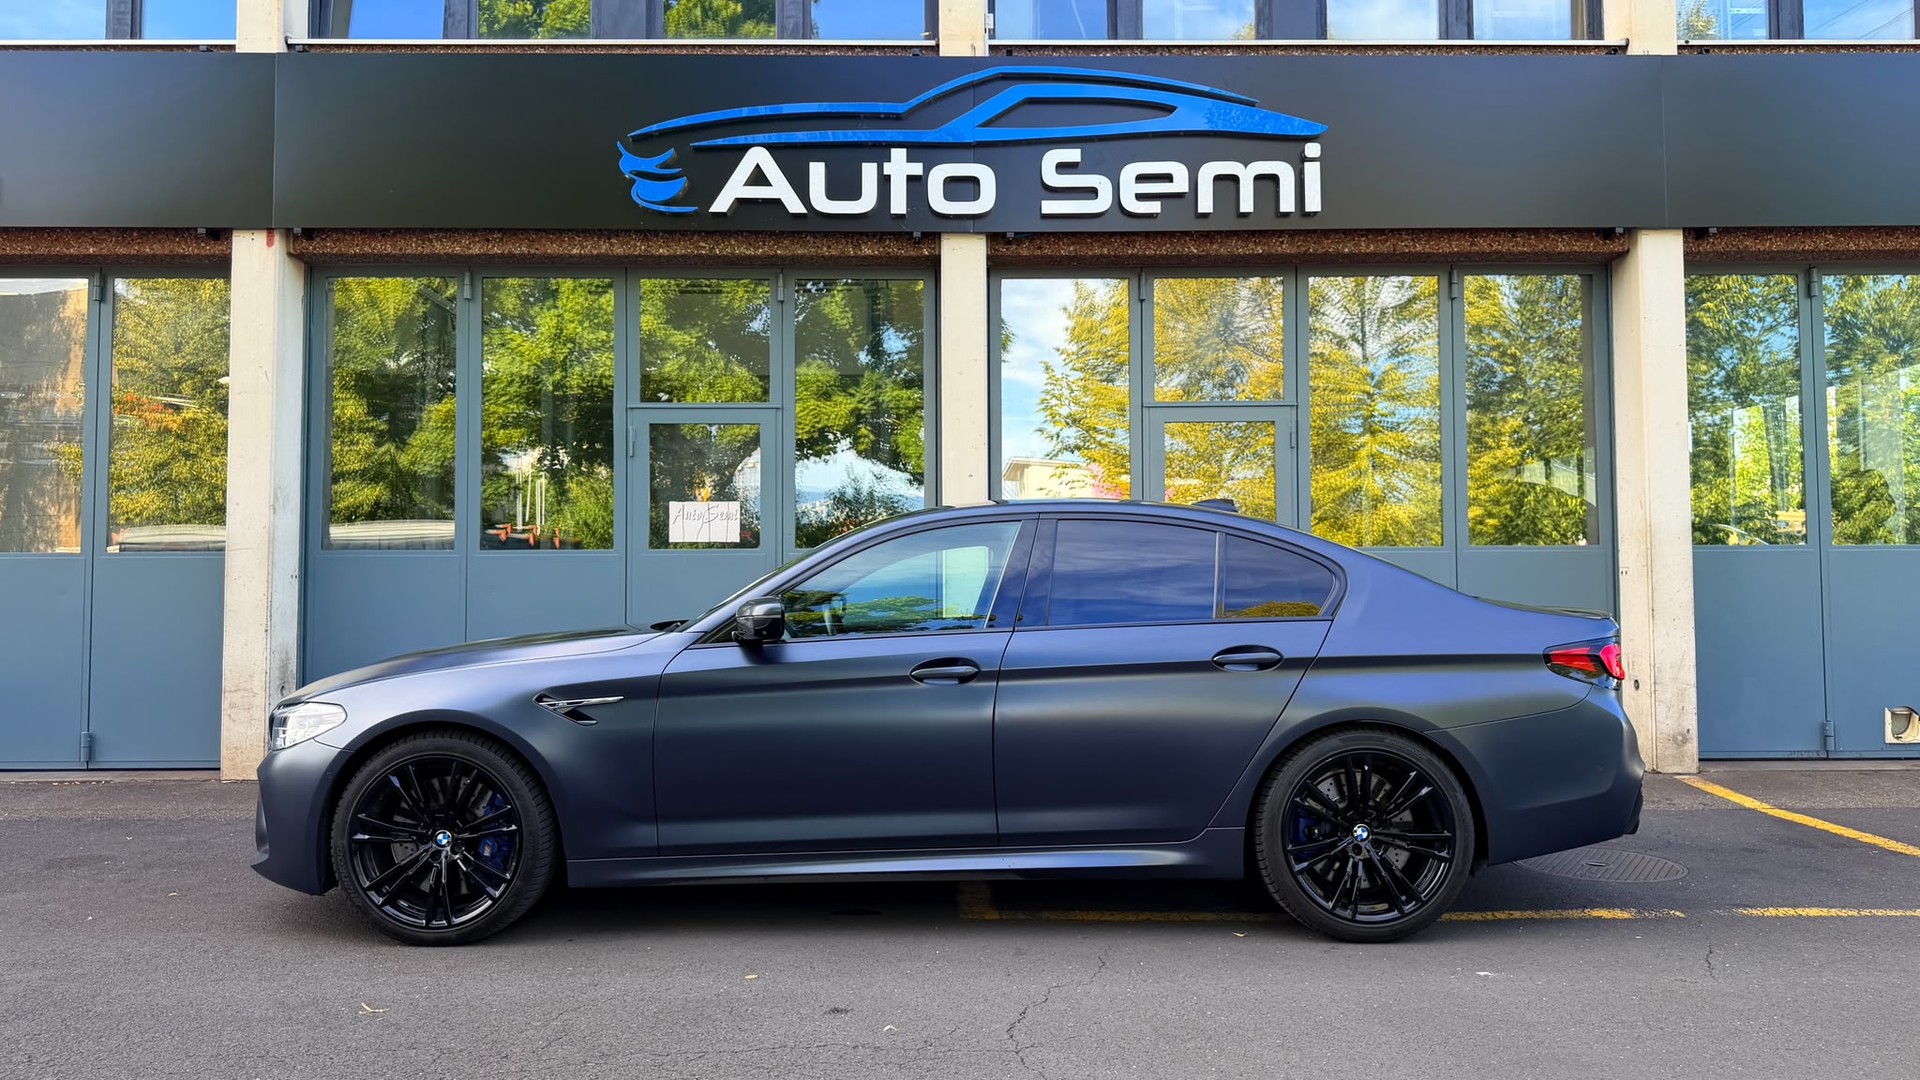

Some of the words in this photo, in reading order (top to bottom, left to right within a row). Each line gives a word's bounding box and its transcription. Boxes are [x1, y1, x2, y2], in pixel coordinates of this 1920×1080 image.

[708, 146, 997, 215] Auto
[1041, 142, 1321, 214] Semi
[673, 503, 703, 525] Auto
[703, 504, 739, 524] Semi
